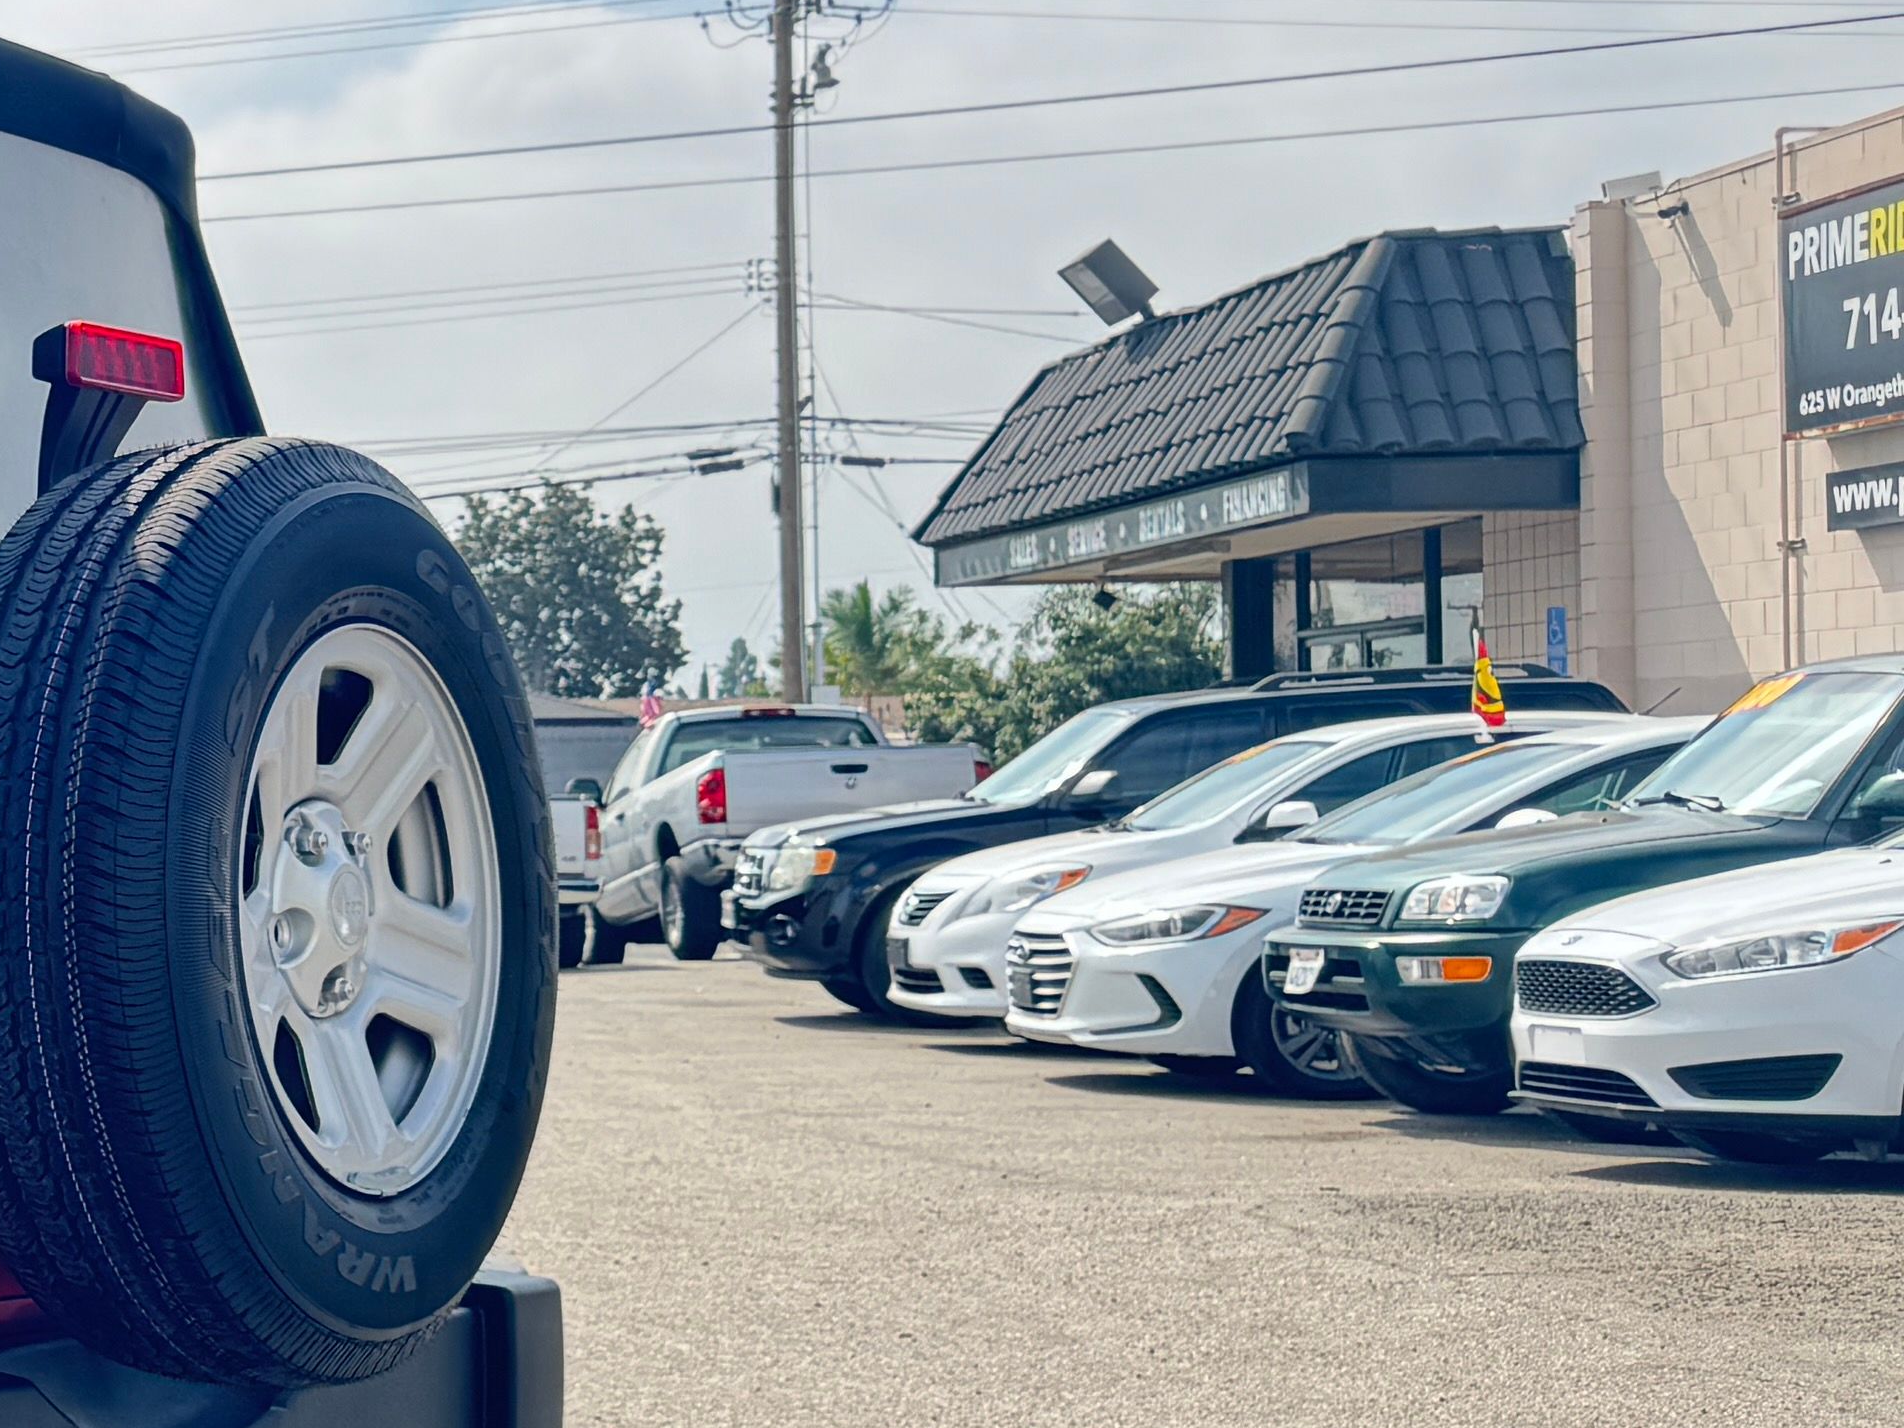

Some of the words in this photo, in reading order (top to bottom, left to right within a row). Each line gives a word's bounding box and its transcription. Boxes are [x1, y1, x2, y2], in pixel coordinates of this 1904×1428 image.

[1799, 389, 1825, 416] 625
[1826, 385, 1842, 411] W
[1009, 532, 1039, 569] SALES
[1138, 500, 1186, 543] RENTALS
[1222, 471, 1290, 525] FINANCING
